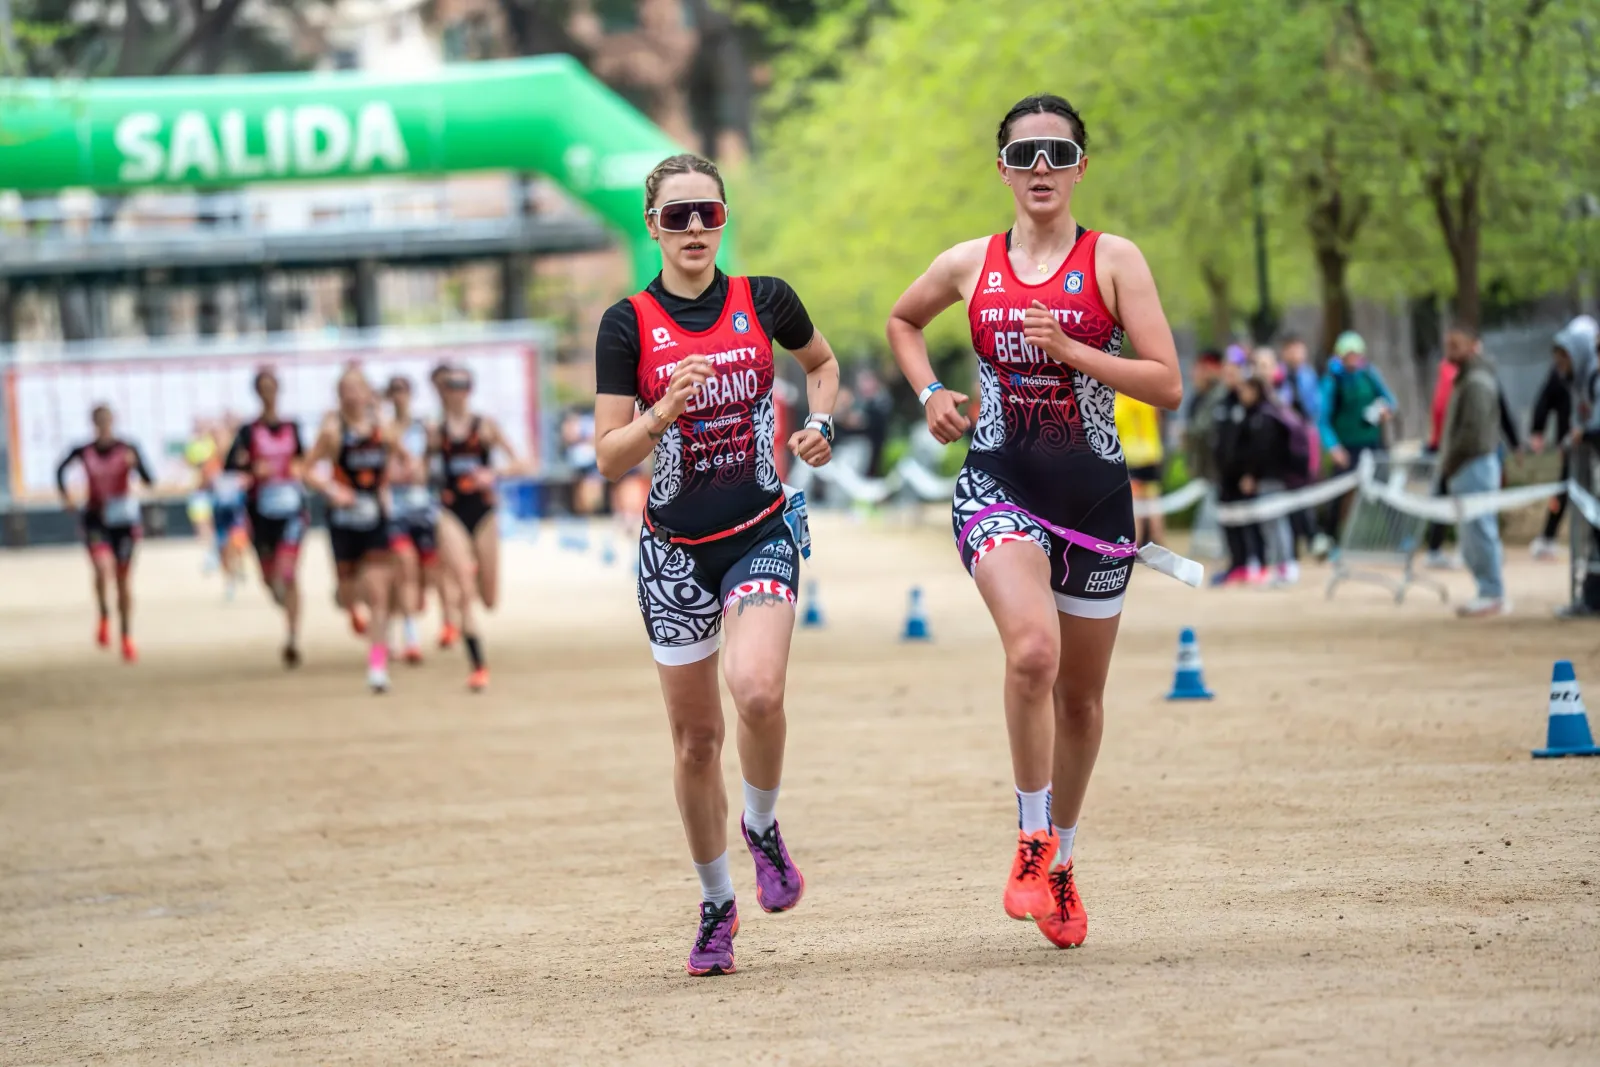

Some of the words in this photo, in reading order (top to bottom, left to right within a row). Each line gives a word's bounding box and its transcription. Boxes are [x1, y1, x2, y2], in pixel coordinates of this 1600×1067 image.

[113, 101, 408, 181] SALIDA
[980, 308, 1003, 323] TRI
[1008, 308, 1084, 324] INITY
[1021, 376, 1060, 386] Móstoles
[705, 416, 742, 430] Móstoles
[713, 450, 746, 466] GEO
[1090, 566, 1127, 582] WINK
[1086, 577, 1124, 591] HAUS
